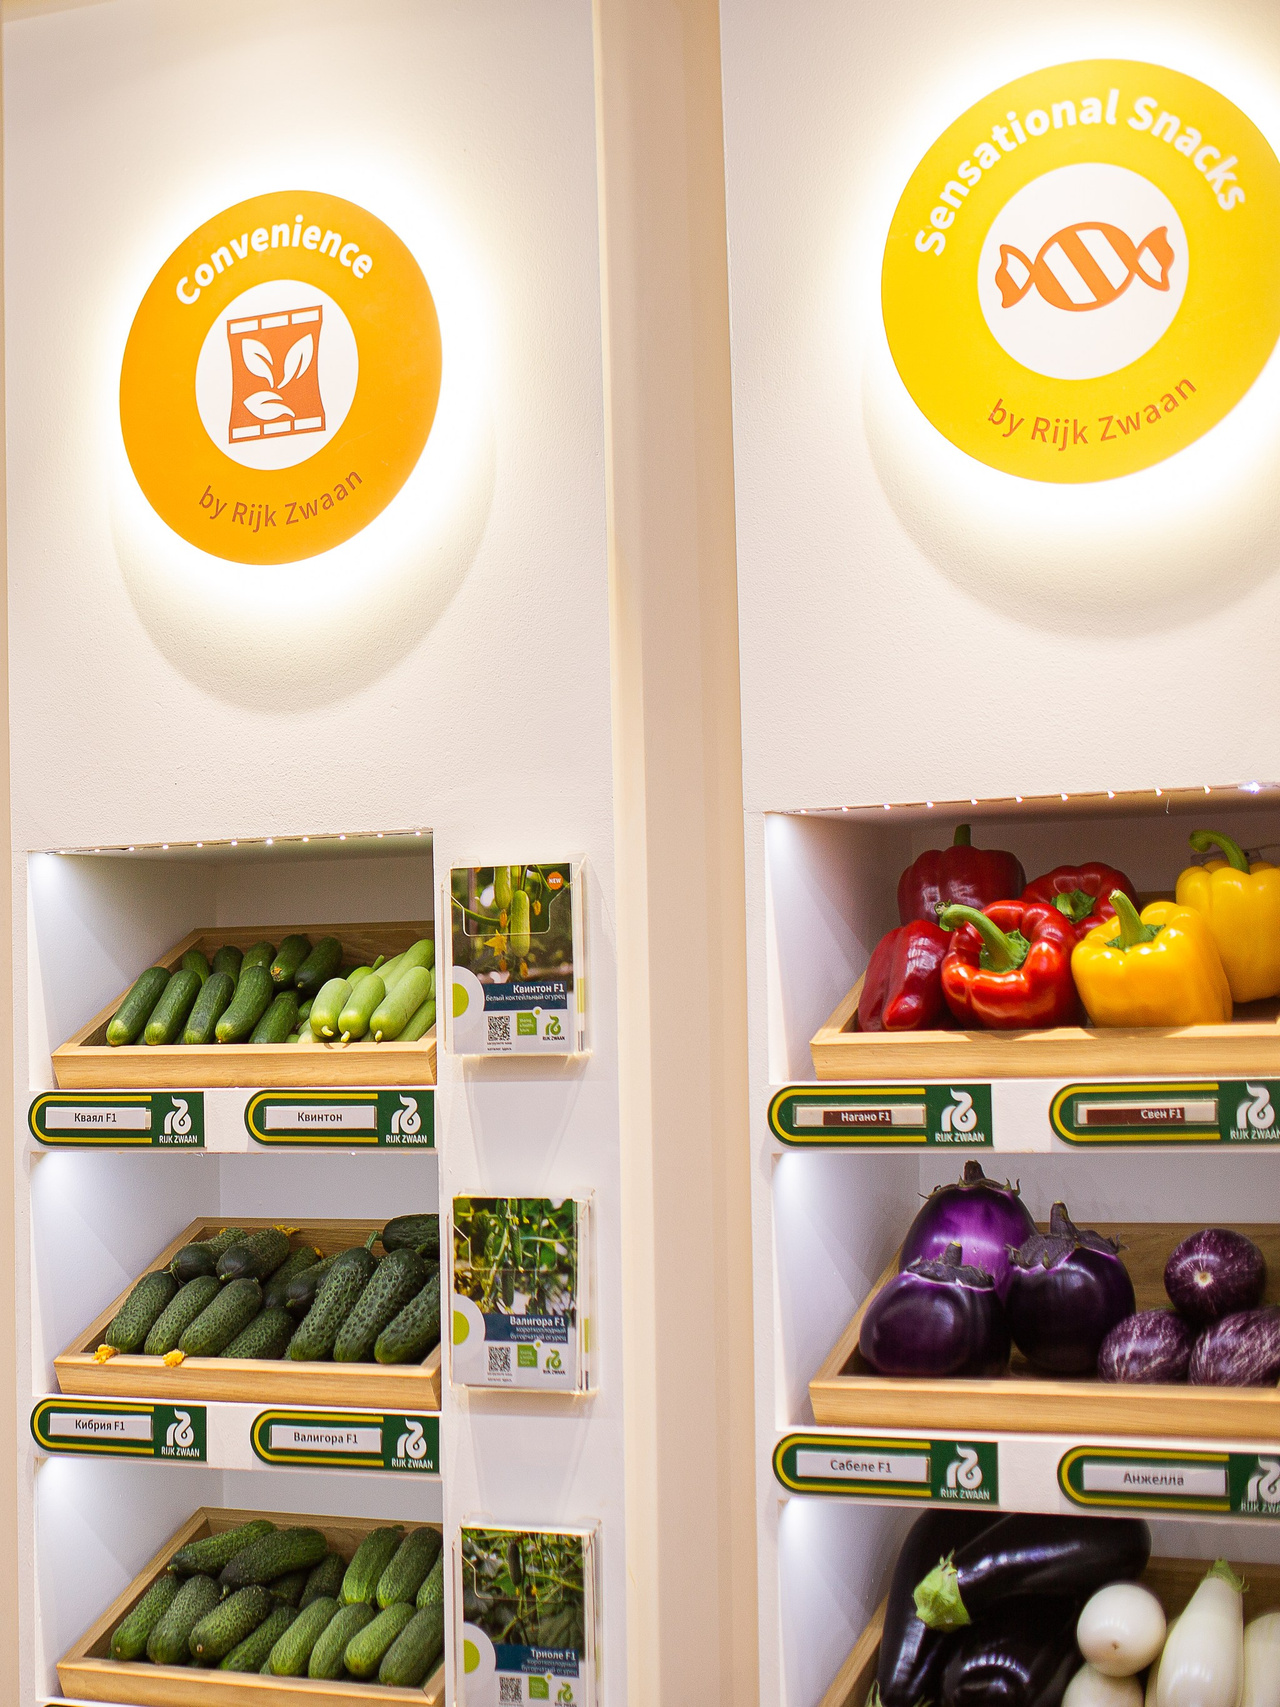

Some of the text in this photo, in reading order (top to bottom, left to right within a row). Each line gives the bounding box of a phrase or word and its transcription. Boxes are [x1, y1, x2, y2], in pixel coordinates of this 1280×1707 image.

[914, 88, 1246, 256] Sensational Snacks
[176, 214, 373, 305] Convenience
[987, 378, 1197, 452] by Rijk Zwaan
[198, 470, 363, 533] by Rijk Zwaan
[513, 983, 564, 994] Квинтон F1
[74, 1113, 117, 1123] Кваял F1
[297, 1112, 343, 1122] Квинтон
[841, 1111, 890, 1122] Нагано F1
[1141, 1109, 1182, 1119] Свен F1
[159, 1135, 198, 1143] RIJK ZWAAN
[385, 1134, 427, 1144] RIJK ZWAAN
[935, 1132, 985, 1142] RIJK ZWAAN
[1230, 1128, 1249, 1139] RIJK
[510, 1316, 565, 1327] Валигора F1
[75, 1419, 125, 1432] Кибрия F1
[293, 1432, 358, 1445] Валигора F1
[161, 1446, 200, 1457] RIJK ZWAAN
[391, 1458, 433, 1469] RIJK ZWAAN
[830, 1459, 892, 1473] Сабеле F1
[1123, 1472, 1184, 1486] Анжелла
[940, 1488, 990, 1500] RIJK ZWAAN
[530, 1648, 576, 1661] Триоле F1
